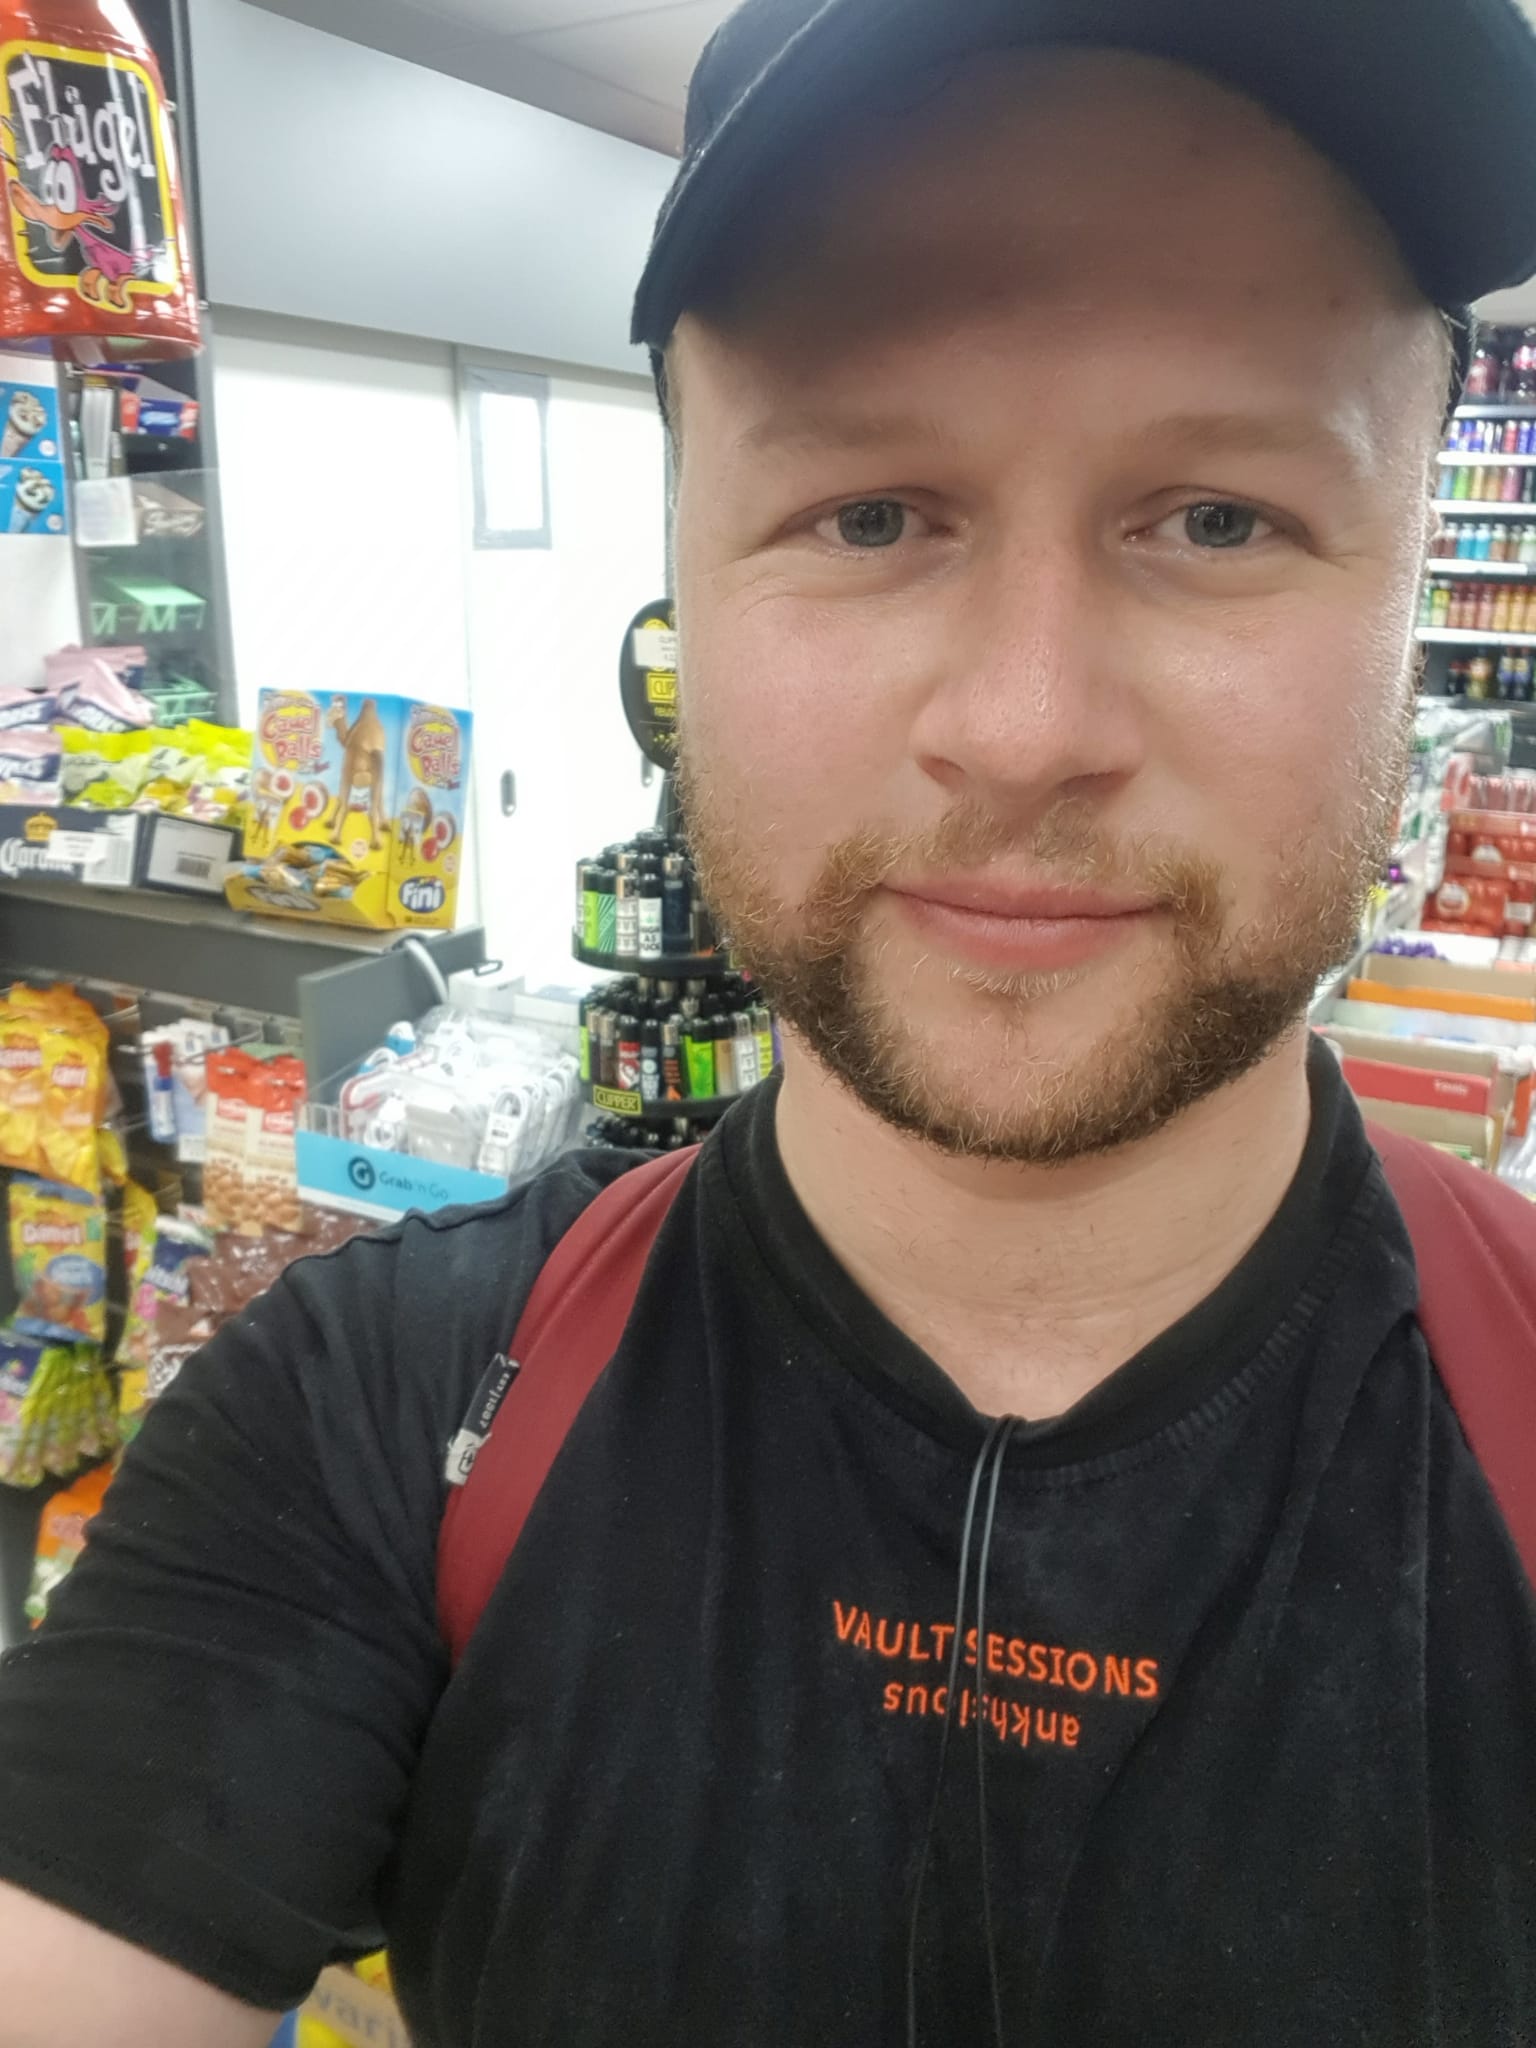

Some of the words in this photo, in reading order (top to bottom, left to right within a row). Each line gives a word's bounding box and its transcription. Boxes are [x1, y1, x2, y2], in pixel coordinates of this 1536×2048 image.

[401, 879, 443, 911] Fini
[596, 1091, 637, 1110] CLIPPER
[379, 1171, 413, 1190] Grab
[428, 1183, 448, 1200] Go
[833, 1600, 955, 1661] VAULT
[965, 1628, 1159, 1698] SESSIONS
